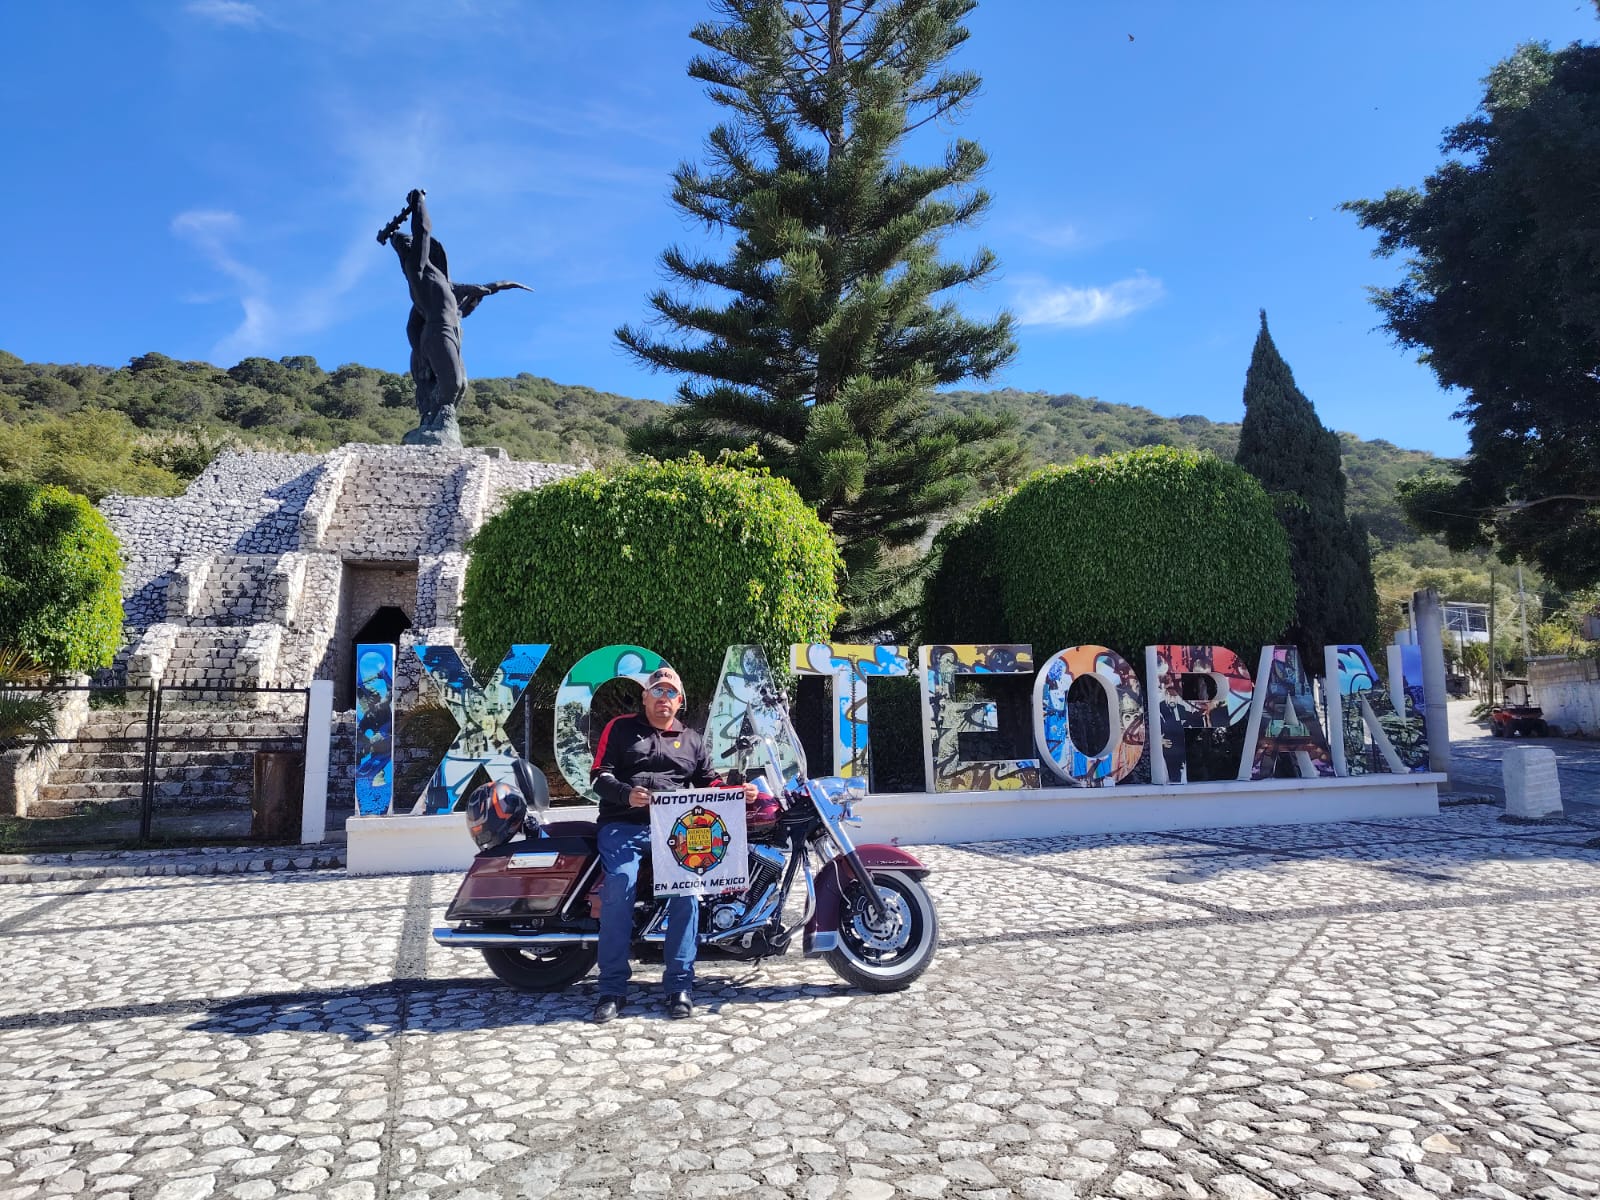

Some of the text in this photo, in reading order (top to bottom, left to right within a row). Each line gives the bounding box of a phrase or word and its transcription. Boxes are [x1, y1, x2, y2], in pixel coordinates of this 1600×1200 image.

[354, 643, 1429, 817] IXCATEOPAN
[651, 792, 744, 805] MOTOTURISMO
[671, 879, 707, 890] ACCIÓN
